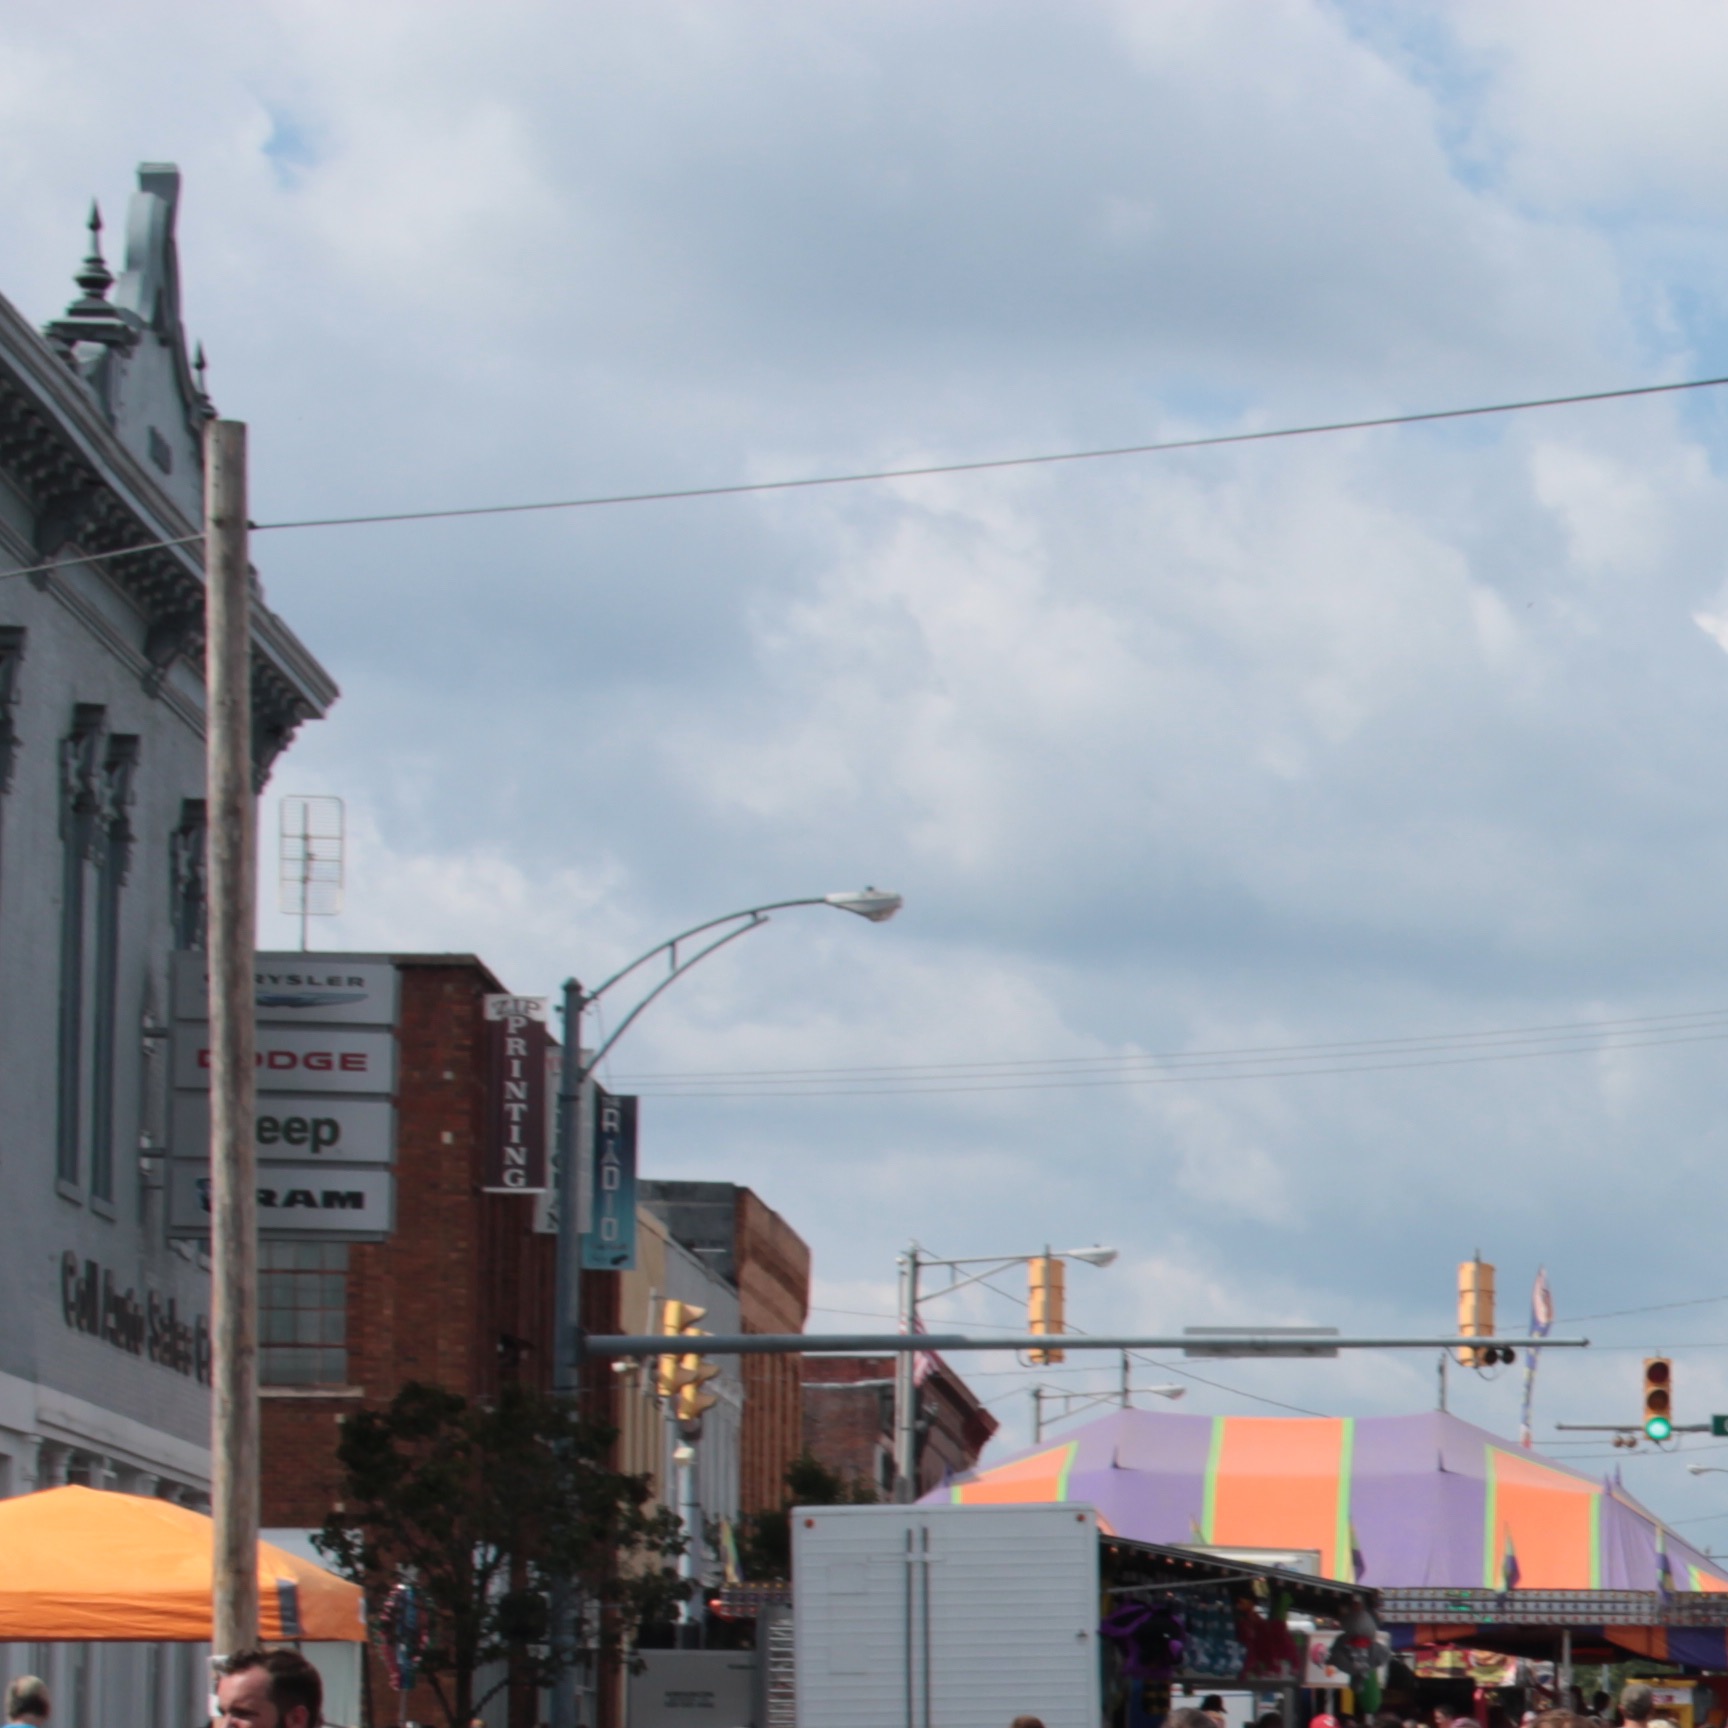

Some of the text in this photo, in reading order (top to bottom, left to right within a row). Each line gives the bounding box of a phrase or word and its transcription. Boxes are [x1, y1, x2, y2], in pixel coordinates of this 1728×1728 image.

[492, 998, 541, 1017] ZIP
[255, 1115, 341, 1154] eep
[501, 1015, 529, 1188] PRINTING
[599, 1108, 621, 1242] RADIO
